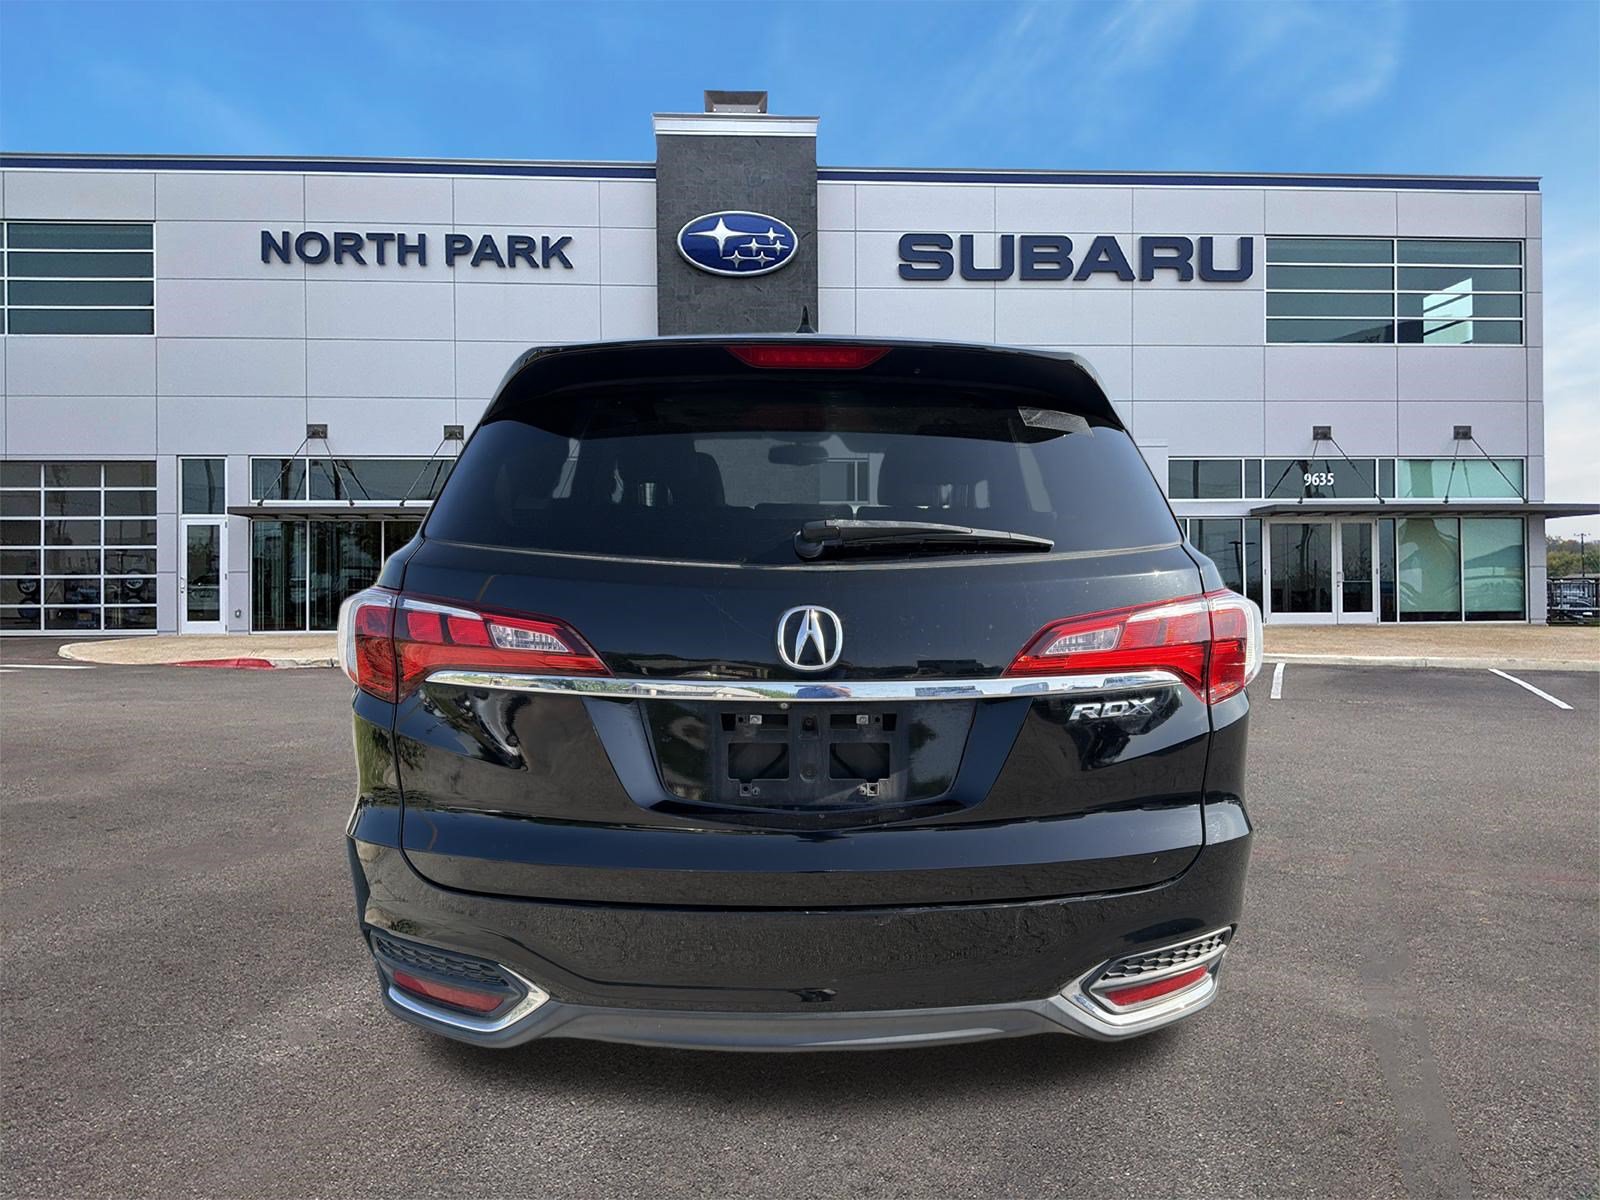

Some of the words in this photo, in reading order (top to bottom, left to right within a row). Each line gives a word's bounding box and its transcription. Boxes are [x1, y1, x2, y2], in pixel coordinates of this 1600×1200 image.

[261, 230, 427, 267] NORTH
[445, 233, 574, 270] PARK
[898, 233, 1254, 282] SUBARU
[1303, 472, 1335, 486] 9635
[1069, 697, 1155, 721] RDX
